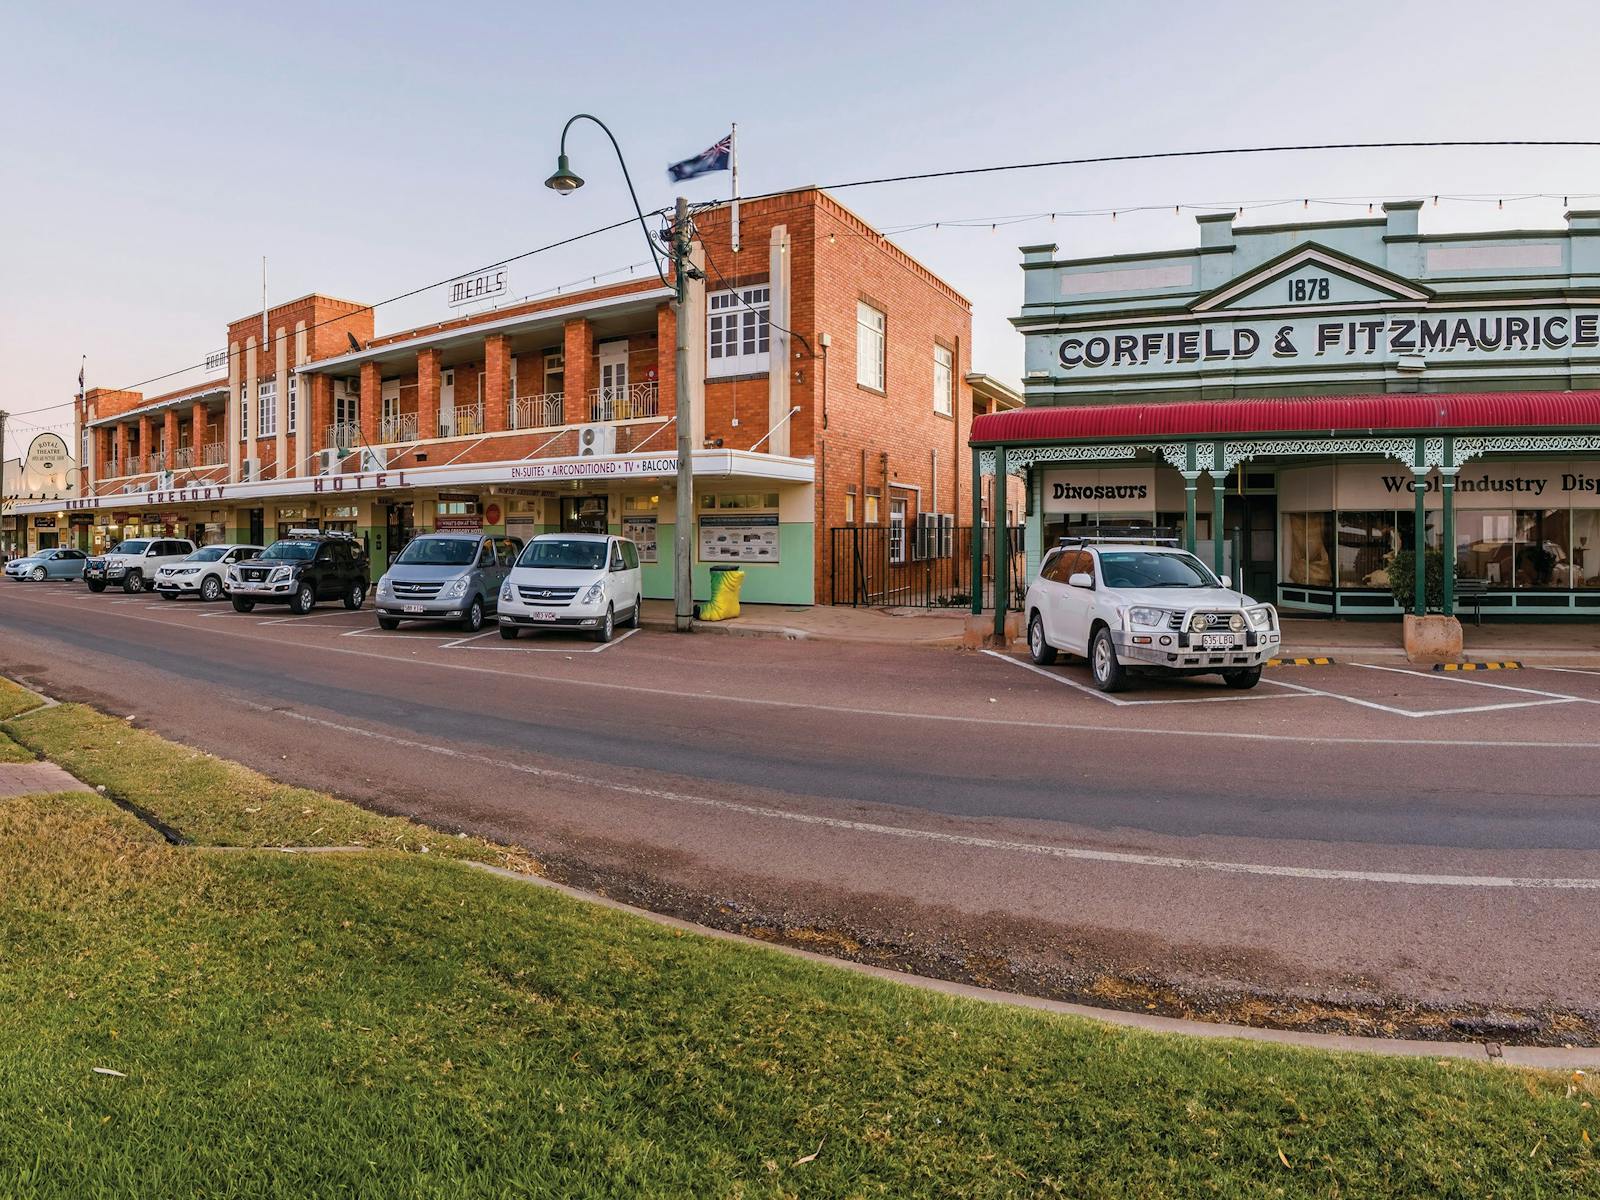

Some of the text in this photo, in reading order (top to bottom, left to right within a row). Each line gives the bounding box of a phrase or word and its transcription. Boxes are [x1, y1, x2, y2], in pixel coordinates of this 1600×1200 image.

[452, 271, 504, 302] MEALS
[1288, 277, 1330, 302] 1878
[1059, 314, 1599, 369] CORFIELD & FITZMAURICE
[206, 351, 228, 370] ROOM
[38, 441, 58, 449] ROYAL
[511, 459, 679, 478] EN-SUITES AIRCONDITIONED TV BALCONI
[66, 471, 411, 509] NORTH GREGORY HOTEL
[1053, 483, 1147, 500] Dinosaurs
[1453, 474, 1547, 495] Industry
